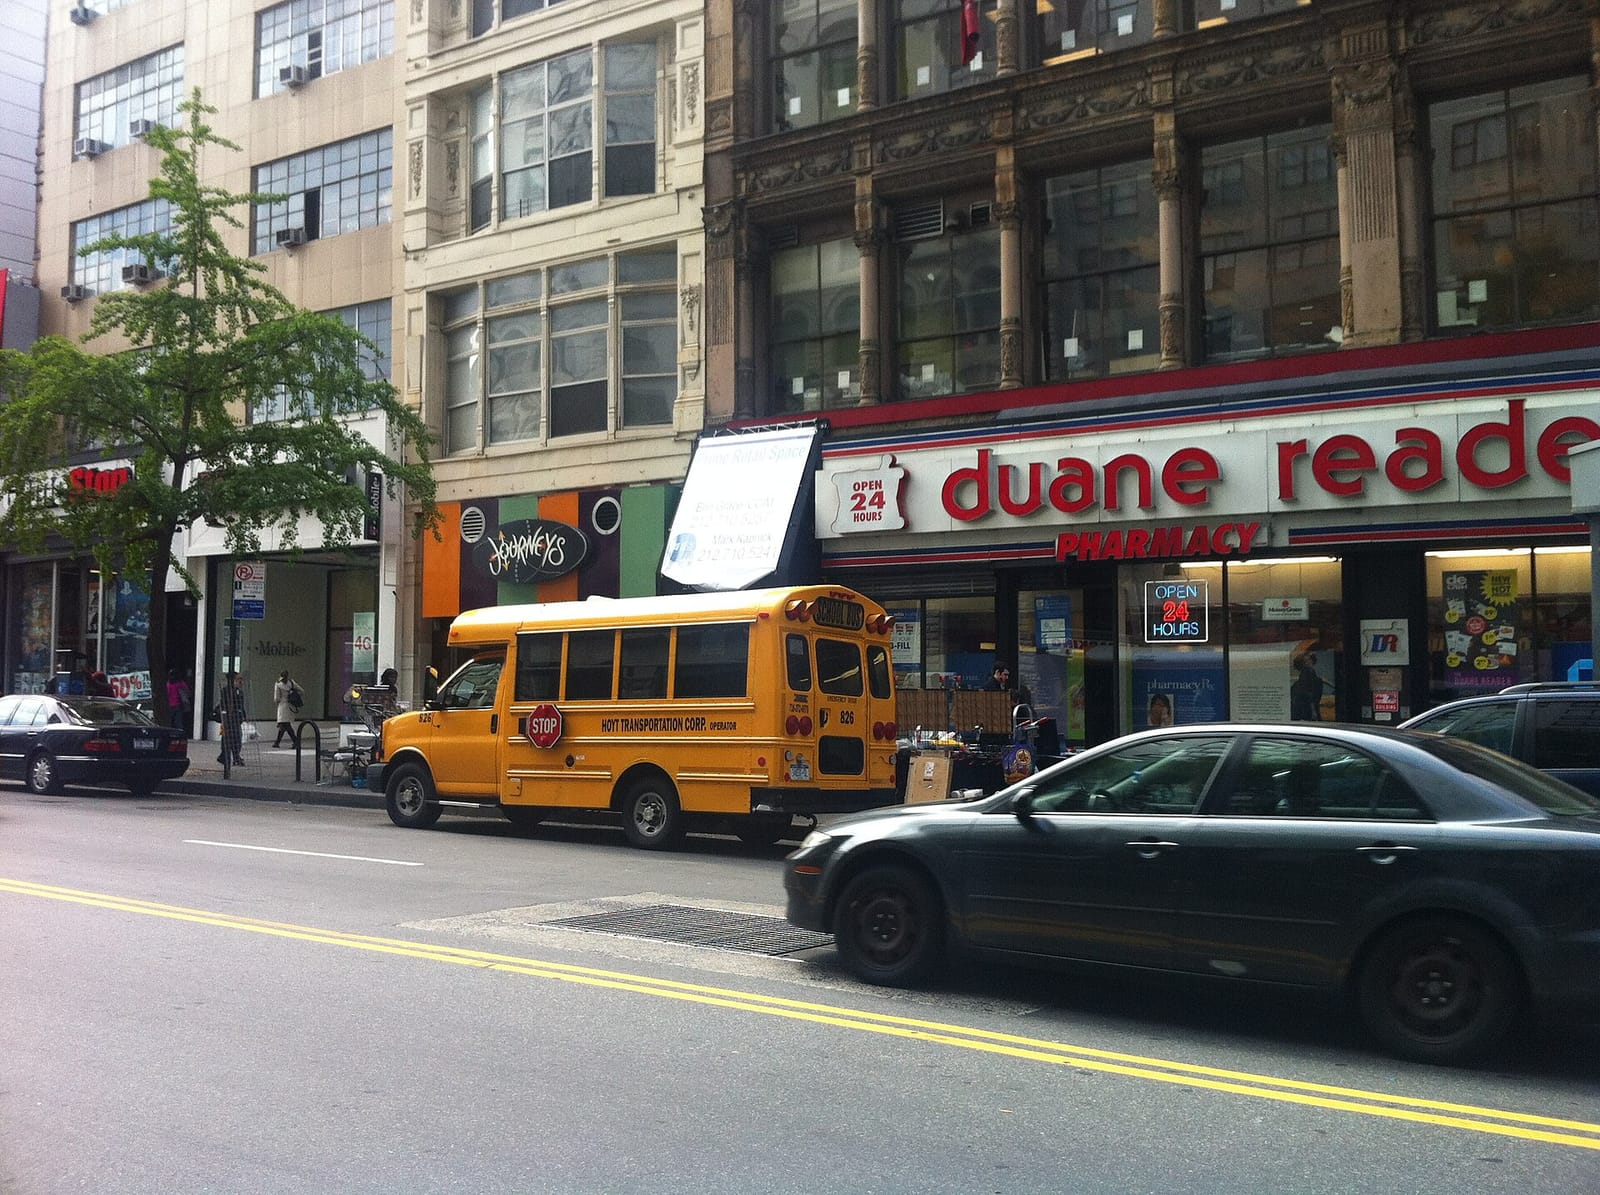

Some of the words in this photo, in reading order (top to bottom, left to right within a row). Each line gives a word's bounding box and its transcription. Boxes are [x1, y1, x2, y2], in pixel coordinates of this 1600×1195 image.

[768, 445, 807, 464] Space
[942, 446, 1222, 522] duane
[1276, 399, 1600, 501] reade
[852, 480, 883, 492] OPEN
[850, 490, 886, 511] 24
[853, 511, 883, 523] HOURS
[1055, 520, 1262, 562] PHARMACY
[488, 526, 566, 576] JOURNEYS
[1155, 585, 1198, 599] OPEN
[816, 599, 843, 624] SCHOOL
[846, 605, 862, 626] BUS
[1163, 600, 1190, 622] 24
[1153, 622, 1200, 637] HOURS
[354, 635, 373, 653] 4G
[1147, 678, 1201, 693] pharmacy
[532, 717, 558, 734] STOP
[601, 718, 620, 733] HOYT
[620, 717, 684, 732] TRANSPORTATION
[684, 716, 707, 731] CORP.
[709, 721, 737, 731] OPERATOR
[840, 710, 855, 725] 826
